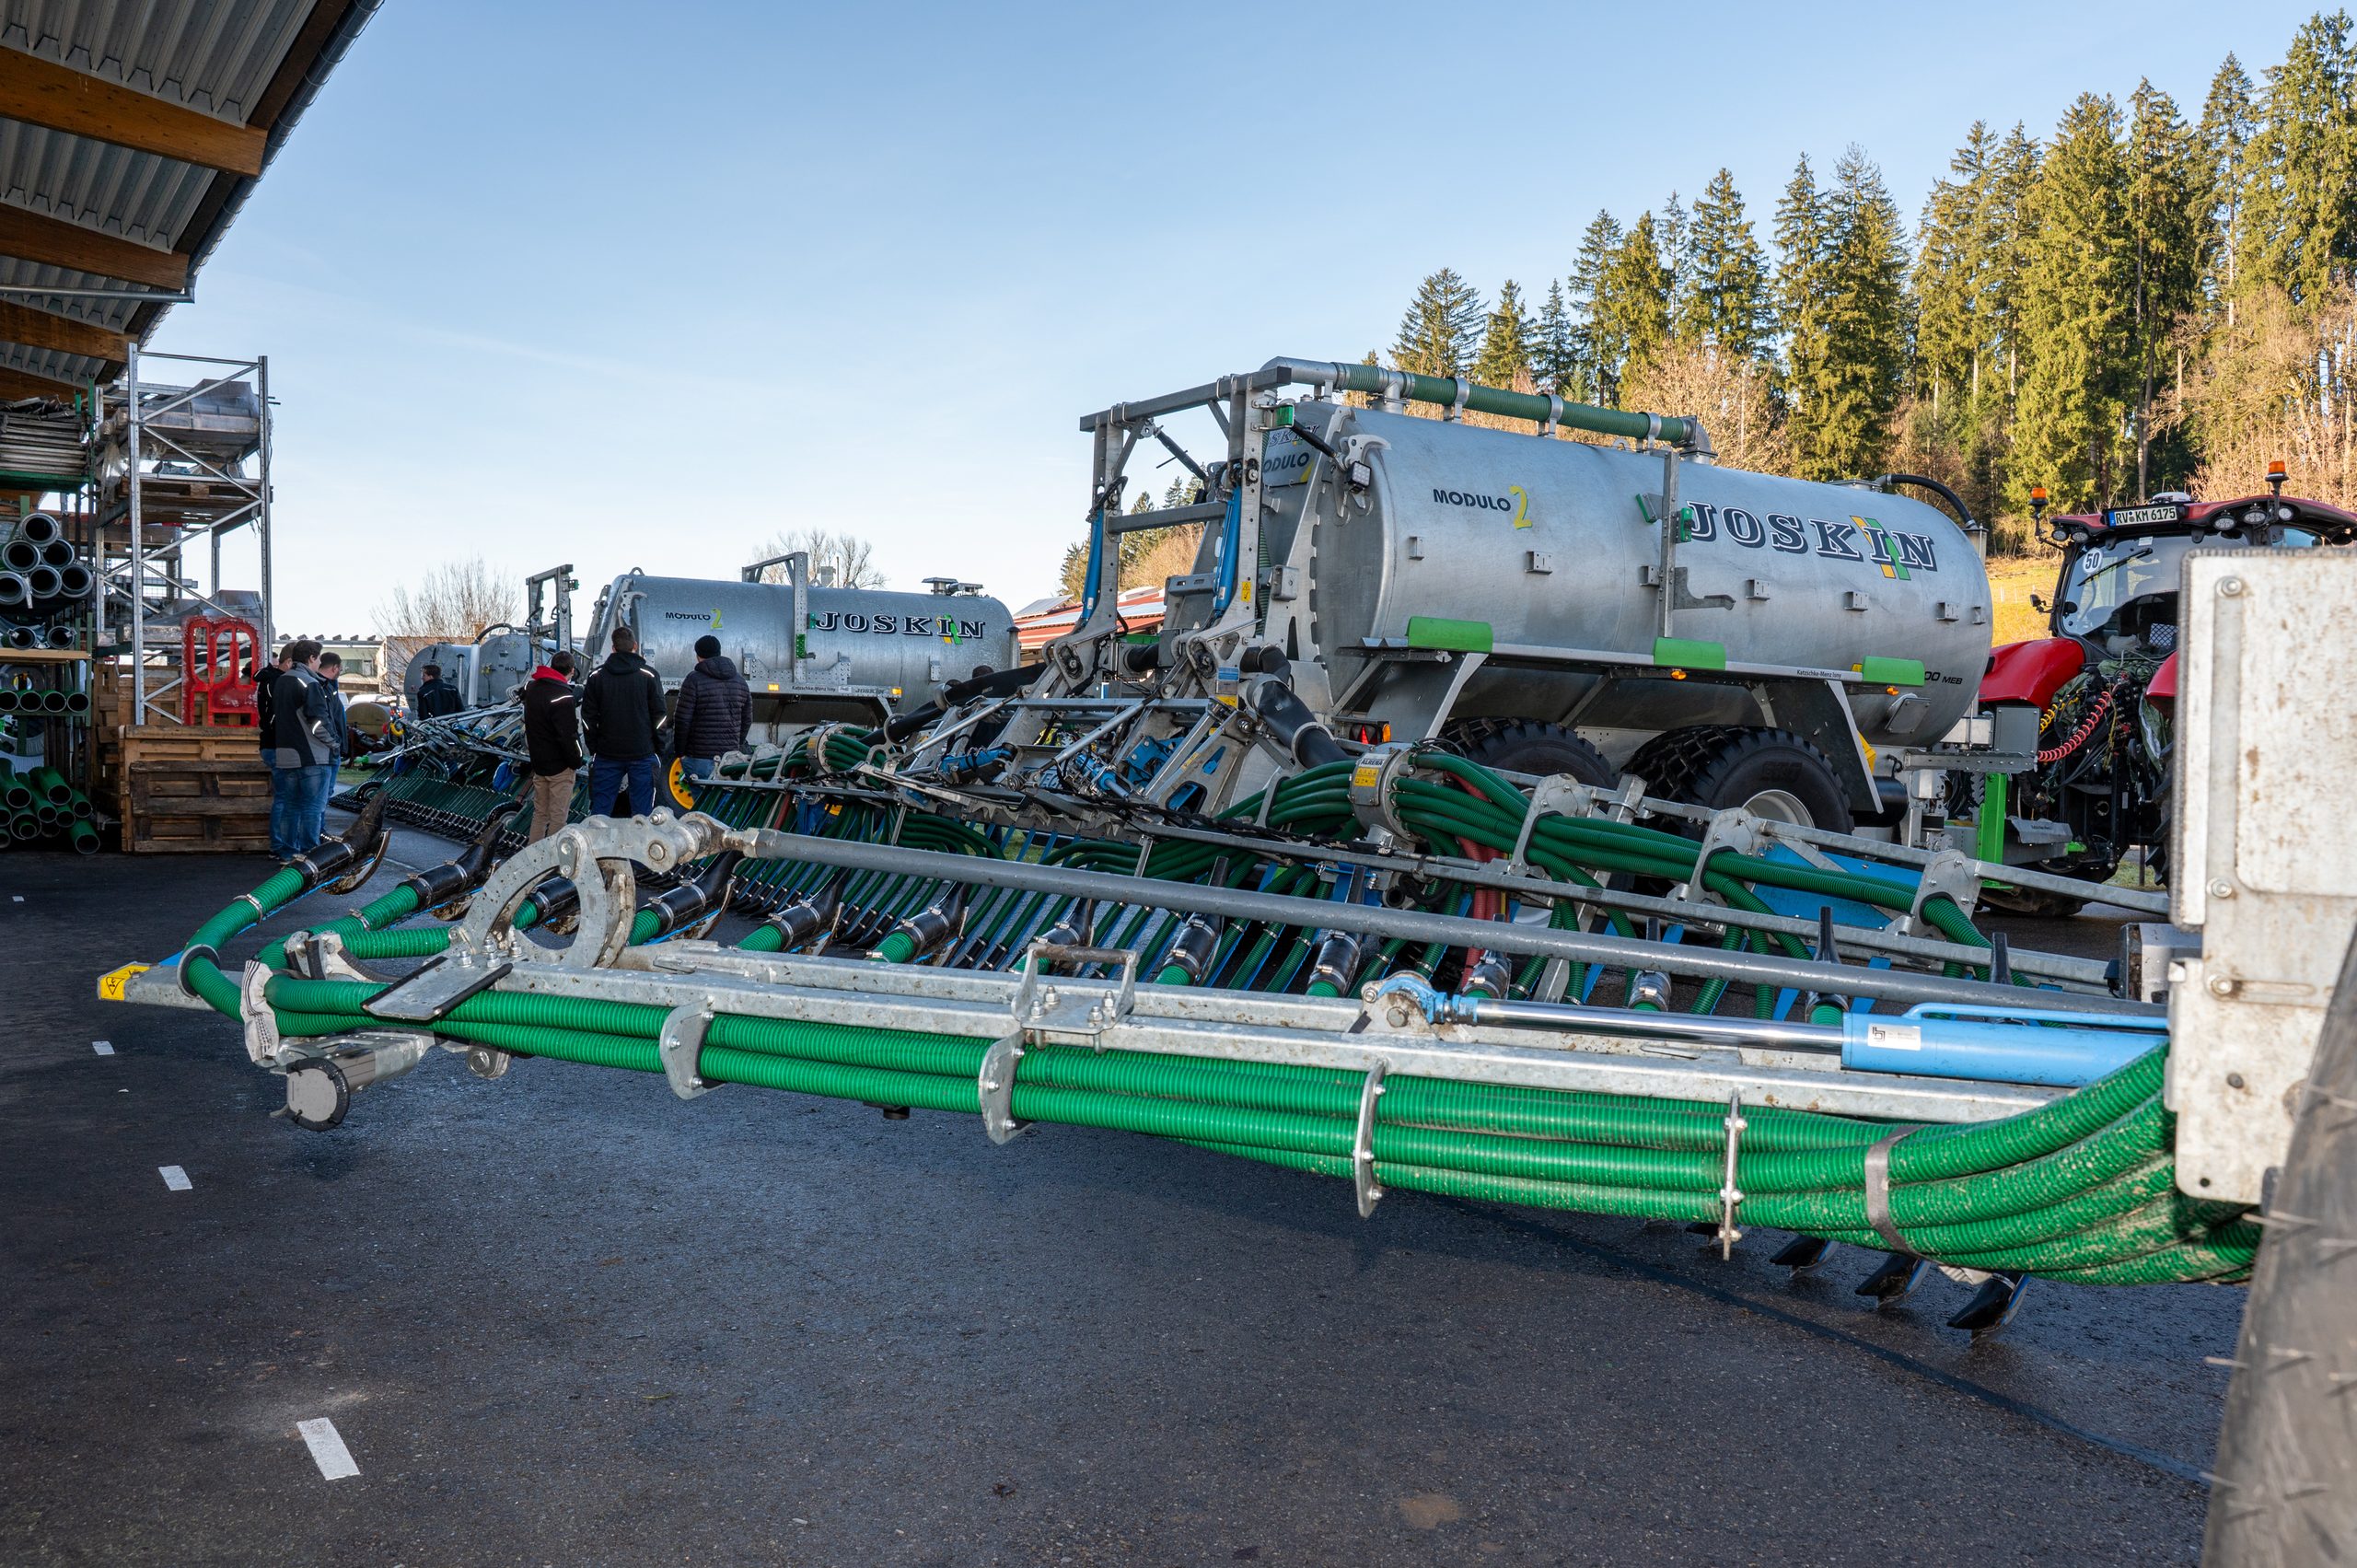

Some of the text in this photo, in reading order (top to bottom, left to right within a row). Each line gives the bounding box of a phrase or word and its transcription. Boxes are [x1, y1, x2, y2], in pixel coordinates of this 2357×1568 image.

[1263, 452, 1310, 473] ODULO
[1433, 485, 1533, 529] MODULO 2
[2115, 507, 2176, 524] RV KM 6175
[1687, 500, 1938, 572] JOSKIN
[2084, 552, 2100, 570] 50
[665, 608, 723, 629] MODULO 2
[815, 611, 985, 639] JOSKIN
[1924, 671, 1963, 684] 00 MEB
